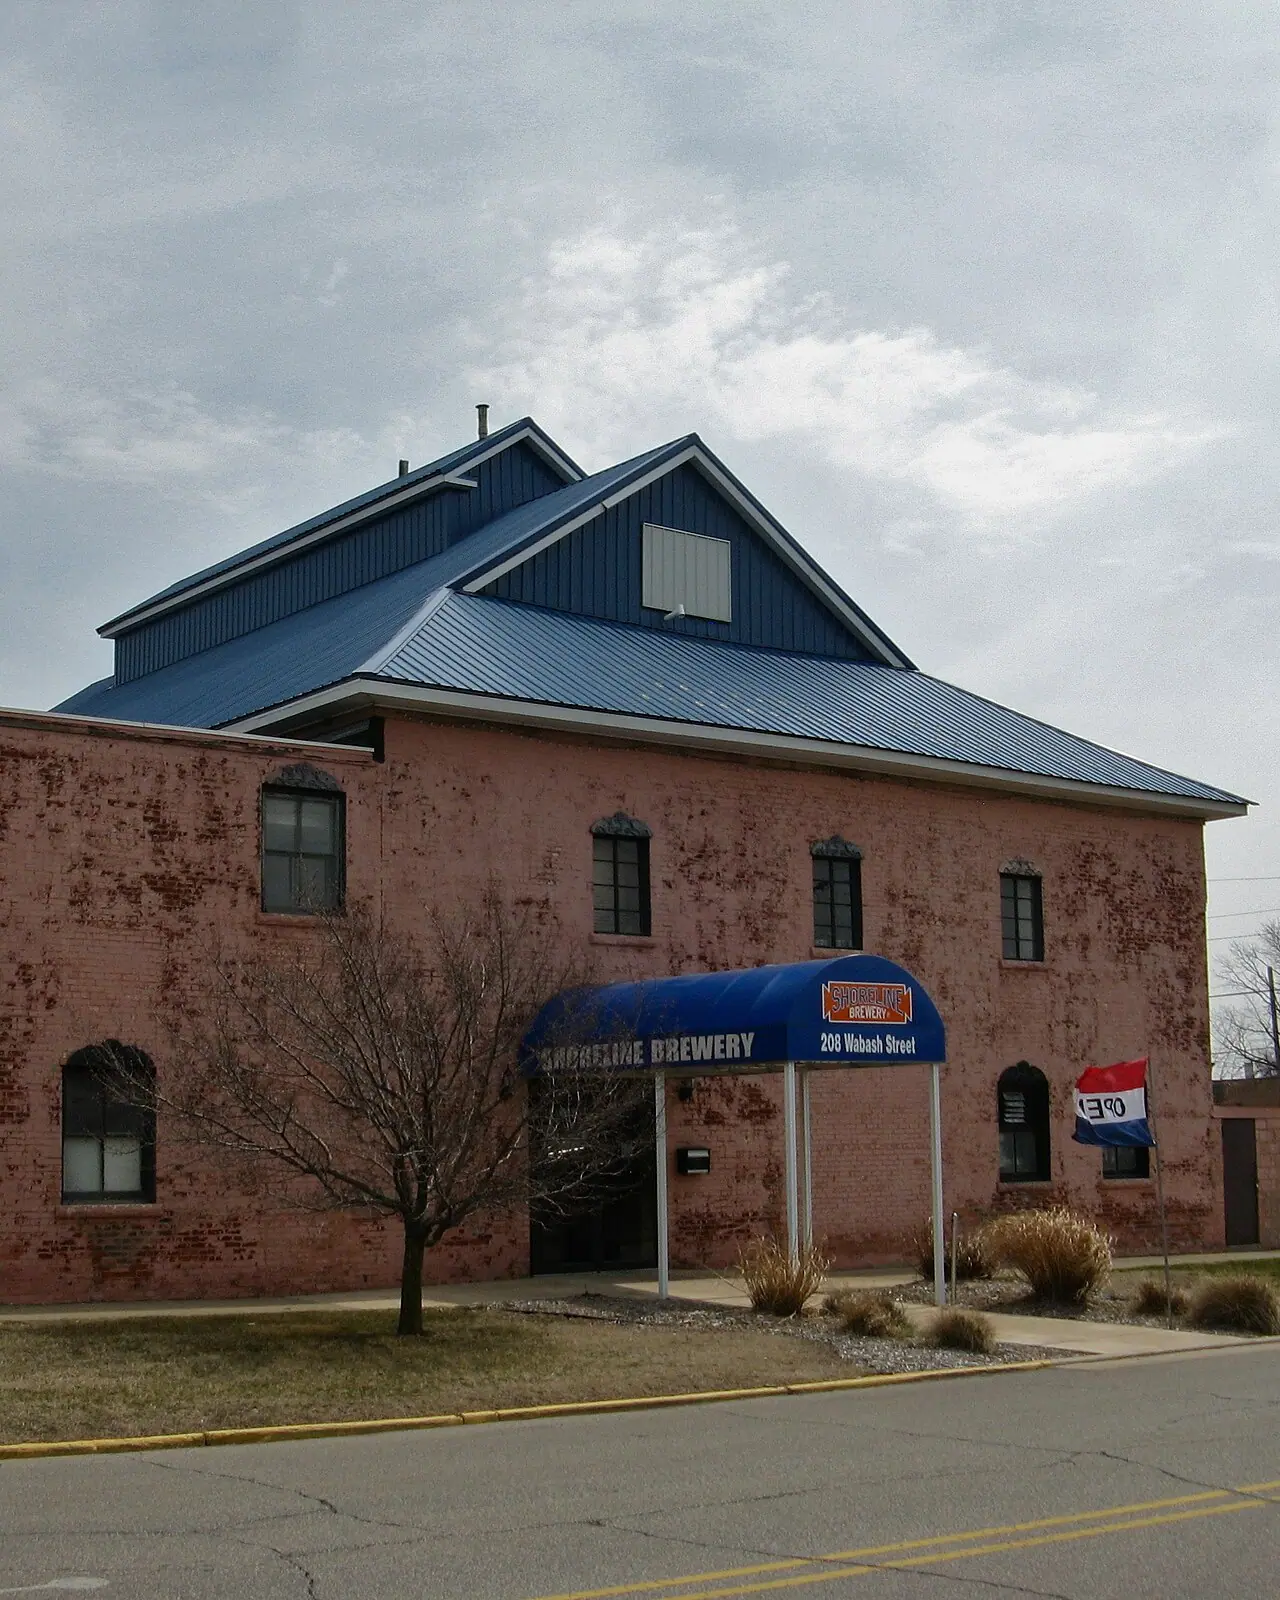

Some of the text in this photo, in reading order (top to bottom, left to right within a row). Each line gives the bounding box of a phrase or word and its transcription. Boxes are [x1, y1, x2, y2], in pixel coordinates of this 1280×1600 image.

[832, 986, 904, 1016] SHORELINE
[849, 1005, 887, 1019] BREWERY
[651, 1032, 755, 1063] BREWERY
[820, 1032, 916, 1054] 208 Wabash Street
